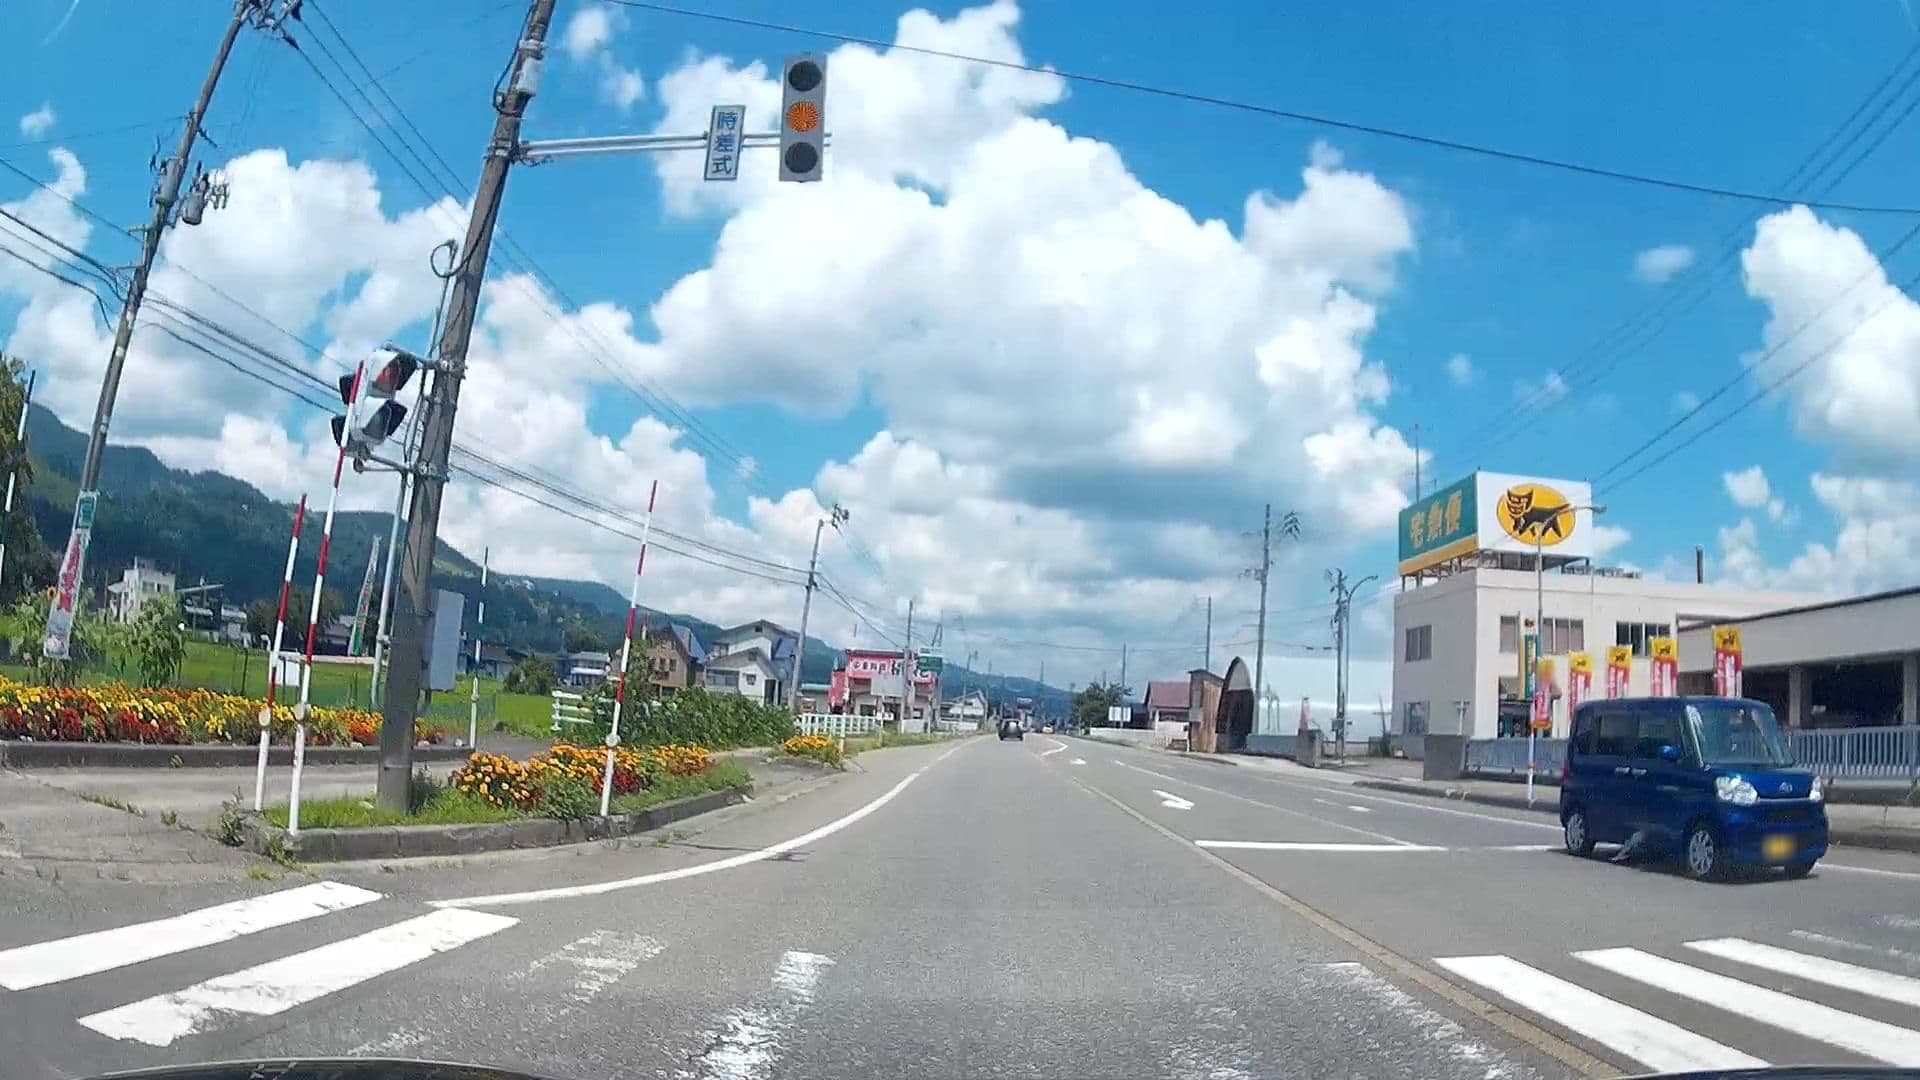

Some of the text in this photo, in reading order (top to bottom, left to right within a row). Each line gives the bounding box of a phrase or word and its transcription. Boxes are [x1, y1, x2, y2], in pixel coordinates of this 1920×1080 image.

[712, 111, 738, 174] 時差式
[1410, 489, 1463, 549] 宅急便
